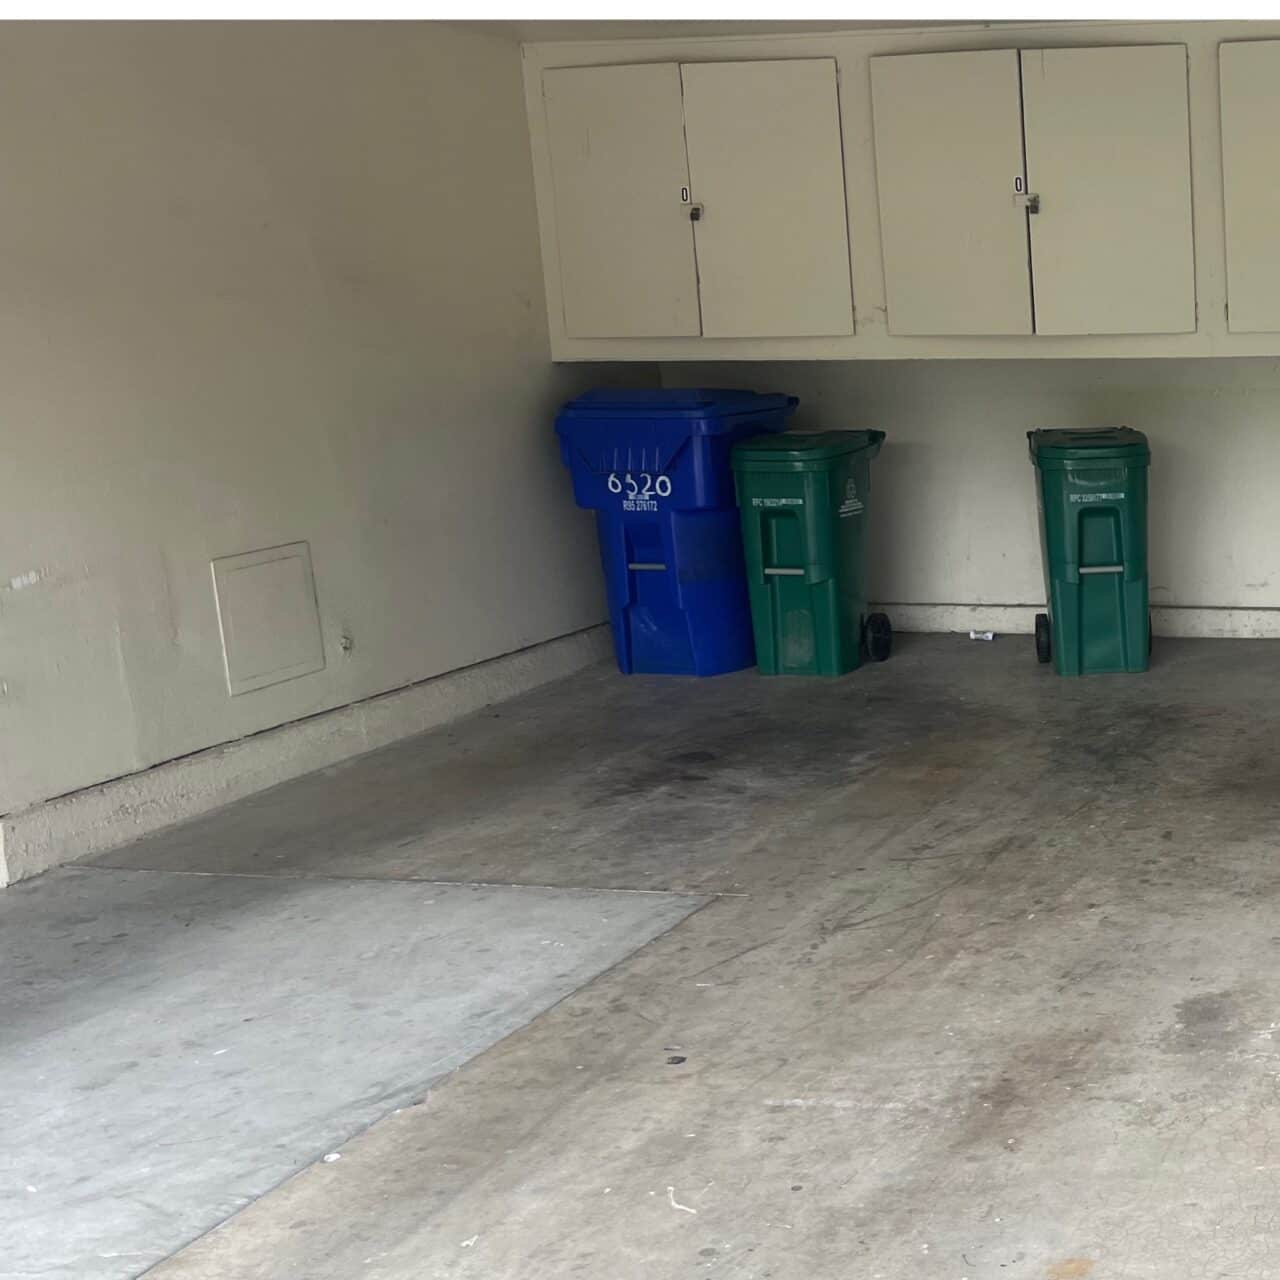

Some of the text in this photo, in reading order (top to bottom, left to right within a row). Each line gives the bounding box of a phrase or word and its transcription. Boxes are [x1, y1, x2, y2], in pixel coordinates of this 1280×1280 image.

[1015, 177, 1022, 192] 0
[681, 187, 688, 201] 0
[608, 473, 671, 496] 6520
